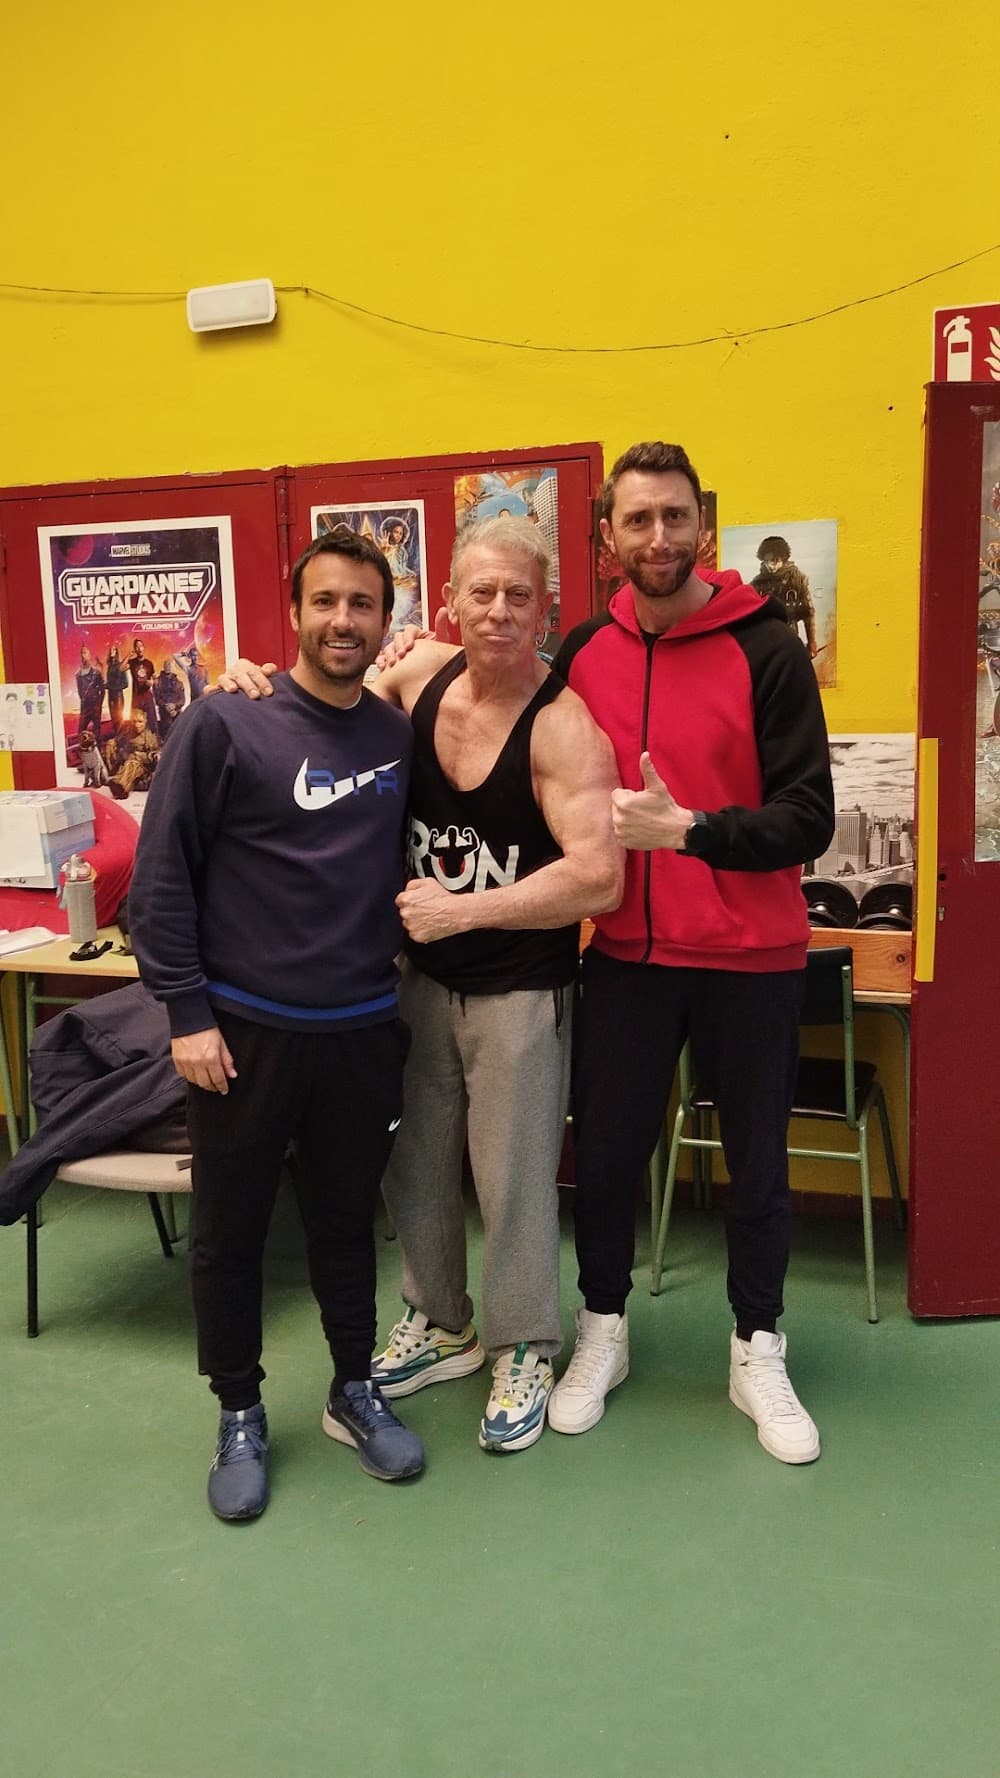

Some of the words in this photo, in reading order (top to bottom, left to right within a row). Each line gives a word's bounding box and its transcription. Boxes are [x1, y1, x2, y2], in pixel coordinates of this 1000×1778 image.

[66, 571, 204, 597] GUARDIANES
[80, 597, 94, 607] DE
[81, 606, 95, 616] LA
[94, 593, 192, 616] GALAXIA
[305, 769, 399, 796] AIR
